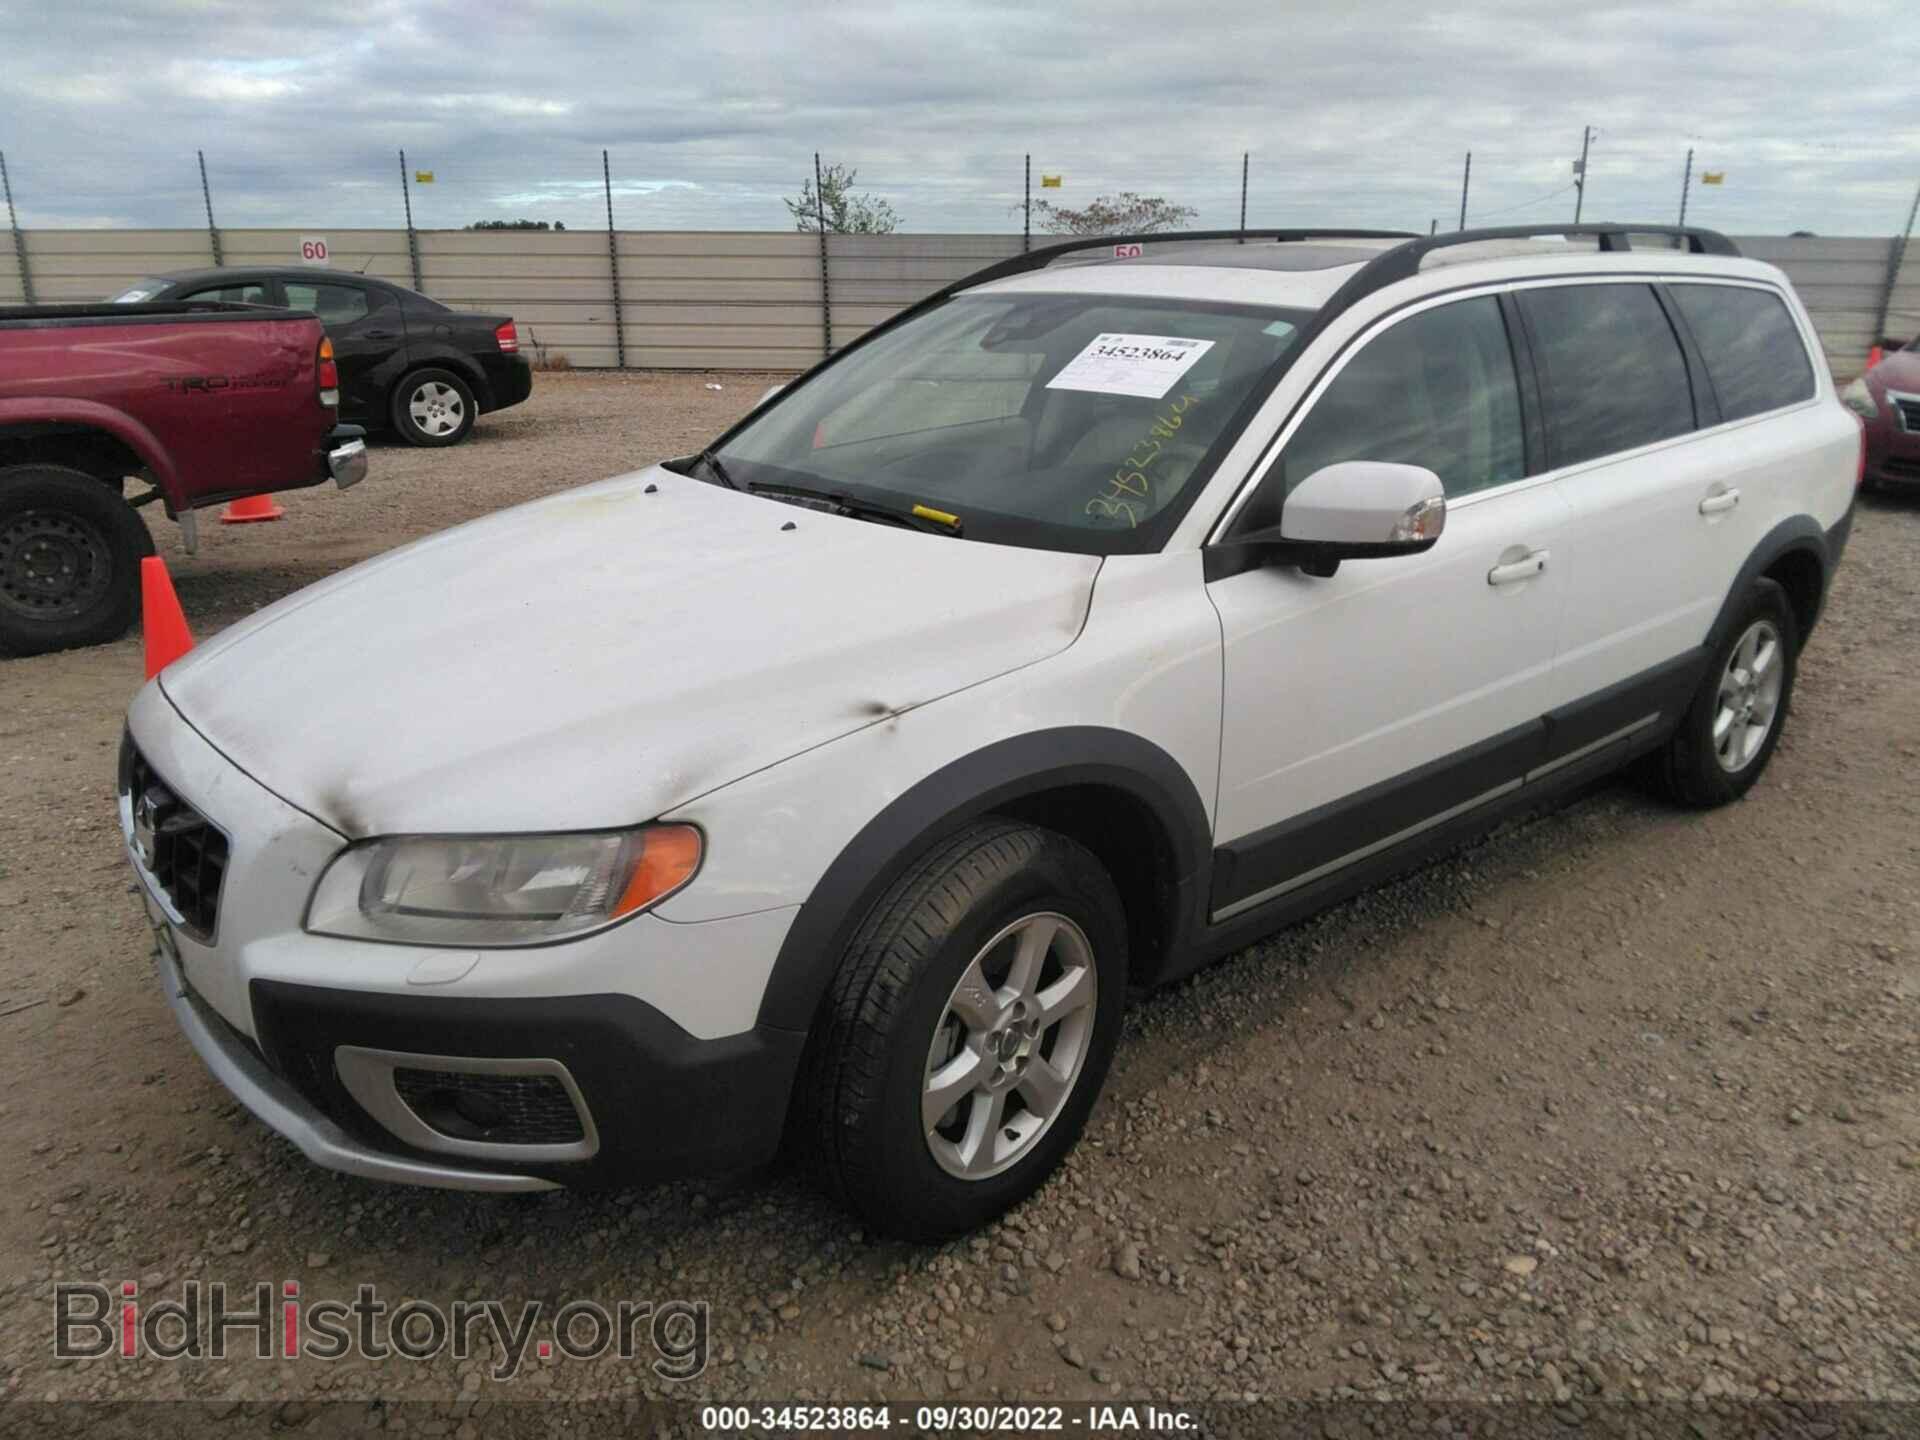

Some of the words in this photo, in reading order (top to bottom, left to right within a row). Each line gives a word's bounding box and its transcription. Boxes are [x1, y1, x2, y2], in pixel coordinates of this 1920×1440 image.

[303, 241, 326, 260] 60
[1090, 344, 1188, 362] 34523864
[1085, 394, 1200, 528] 34523864
